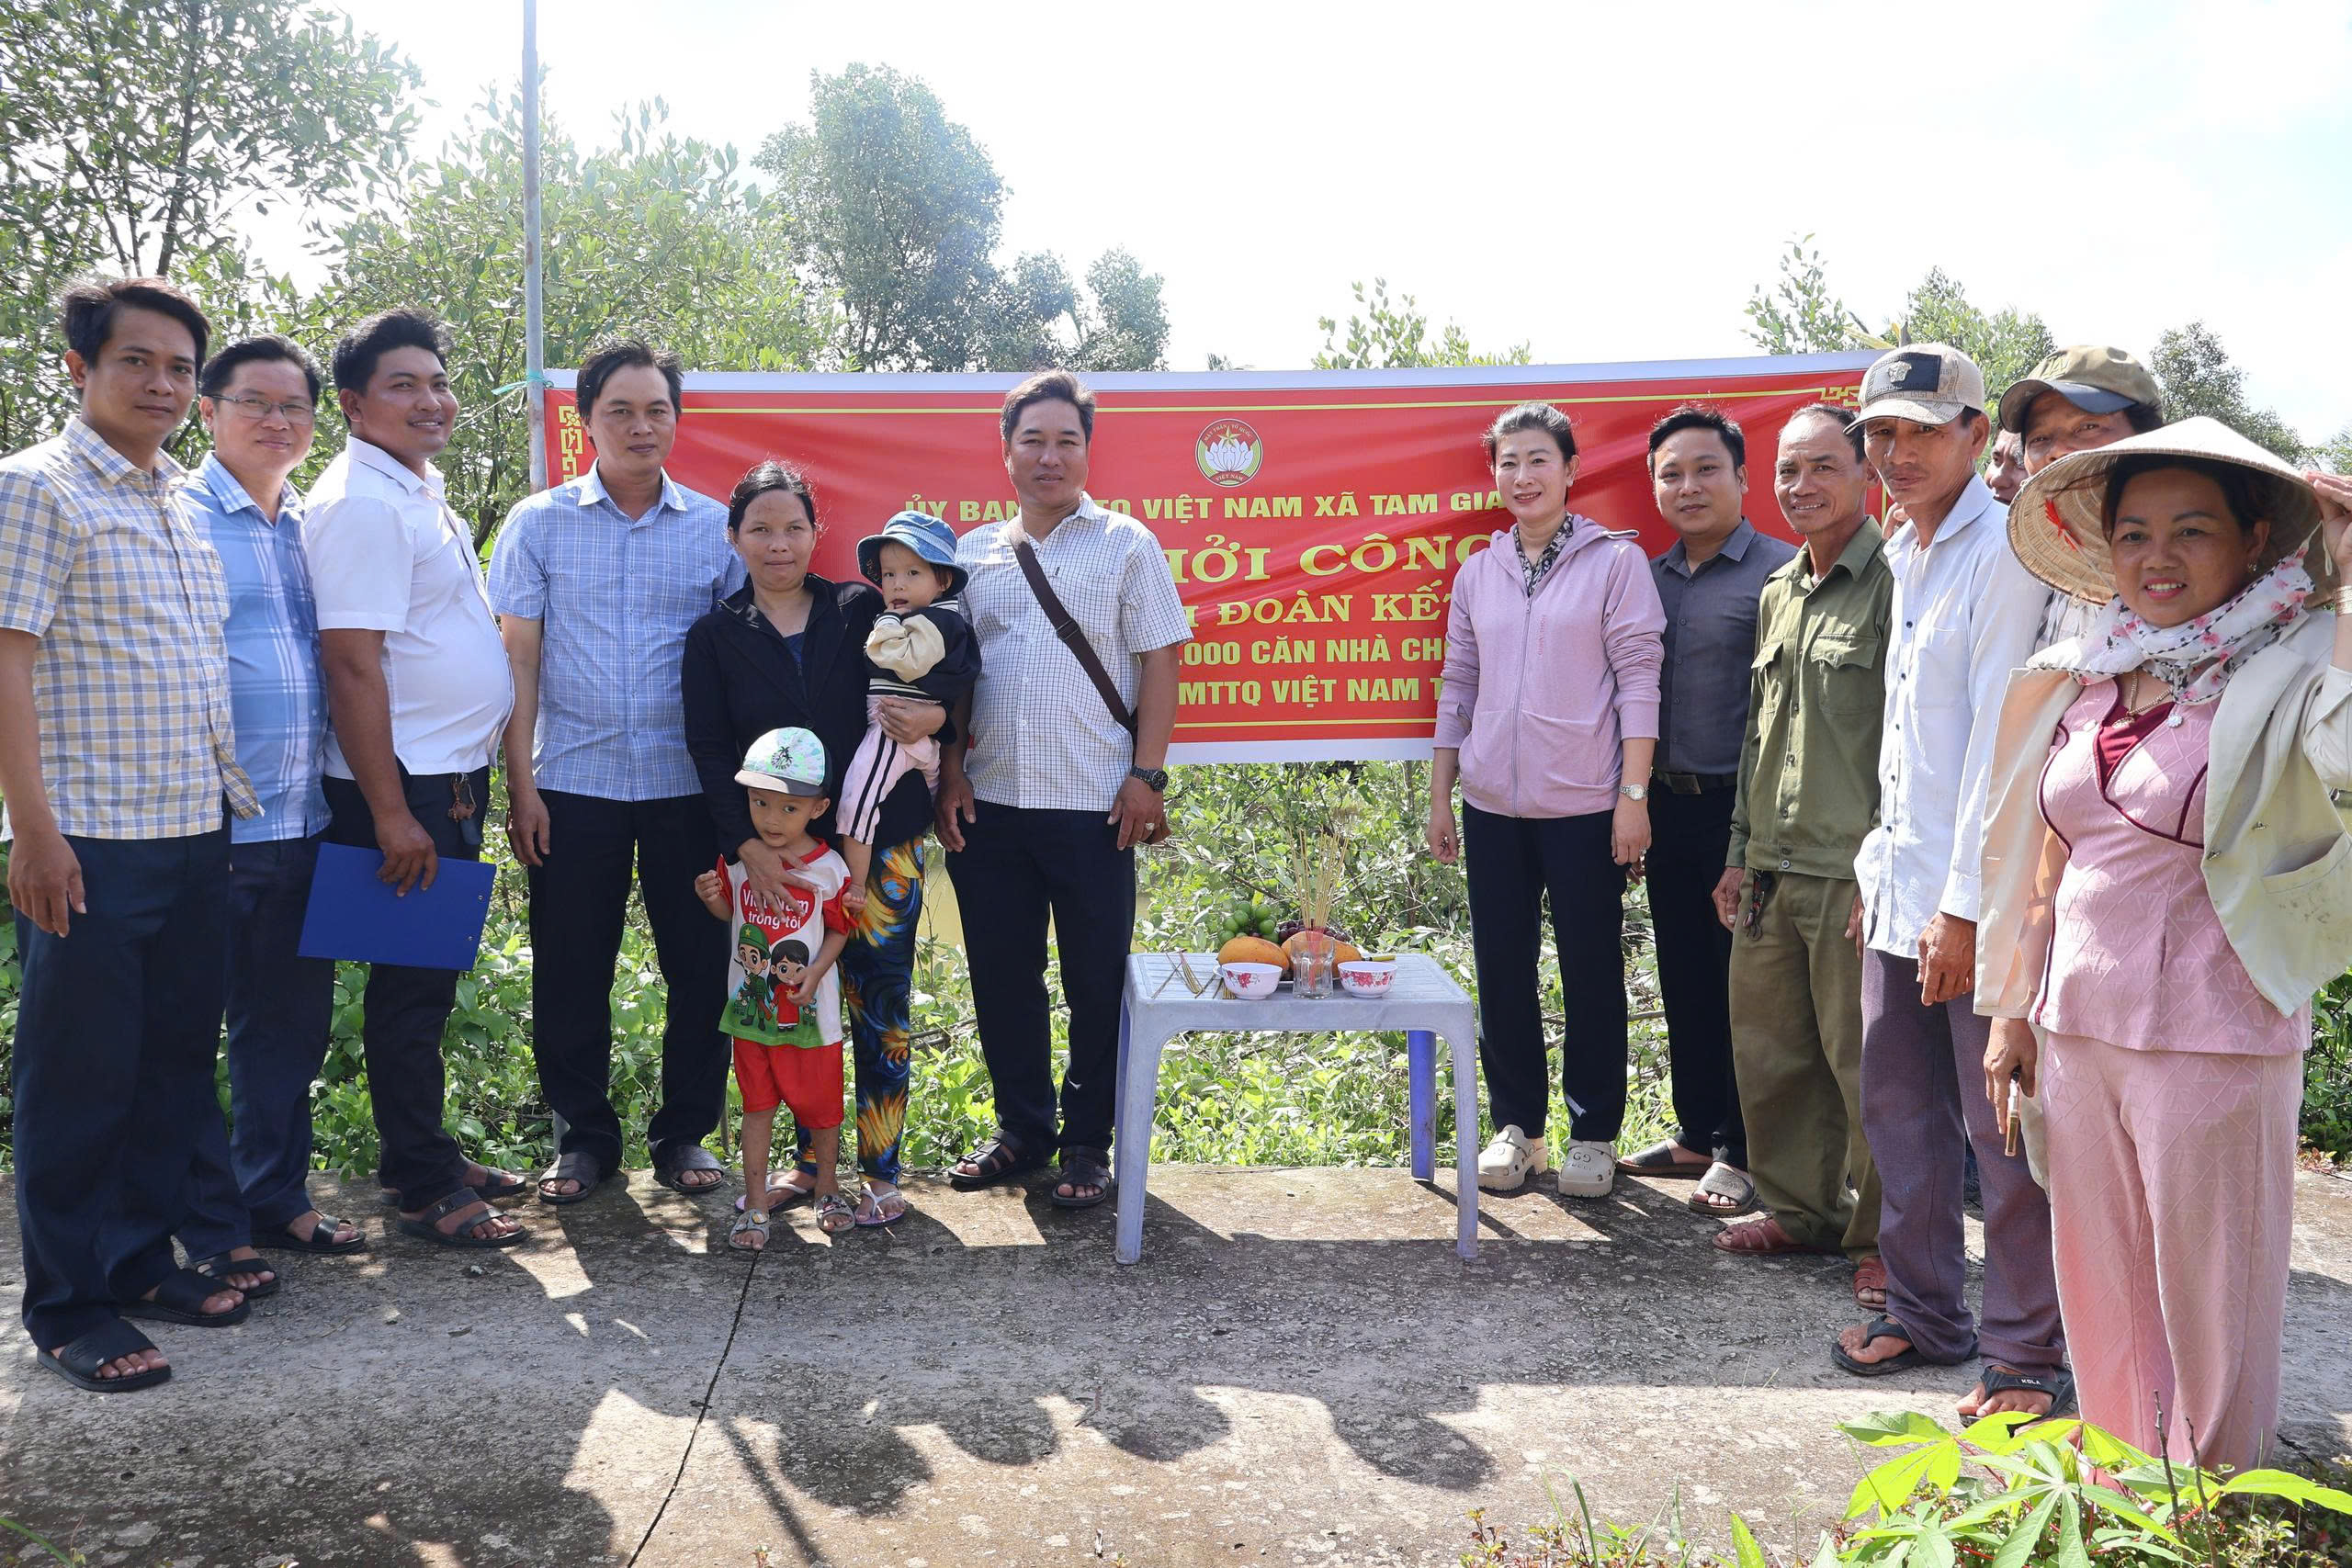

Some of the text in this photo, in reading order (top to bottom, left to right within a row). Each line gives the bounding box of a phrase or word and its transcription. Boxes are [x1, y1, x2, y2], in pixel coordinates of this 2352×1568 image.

[1142, 493, 1214, 524] VIỆT
[1224, 496, 1303, 518] NAM
[1314, 491, 1360, 516] XÃ
[1369, 493, 1439, 515] TAM
[1450, 491, 1508, 511] GIA
[1216, 589, 1353, 626] ĐOÀN
[1251, 635, 1316, 665] CĂN
[1326, 633, 1391, 663] NHÀ
[1401, 637, 1452, 662] CH
[1178, 680, 1261, 706] MTTQ
[1271, 674, 1338, 708] VIỆT
[1347, 677, 1419, 703] NAM
